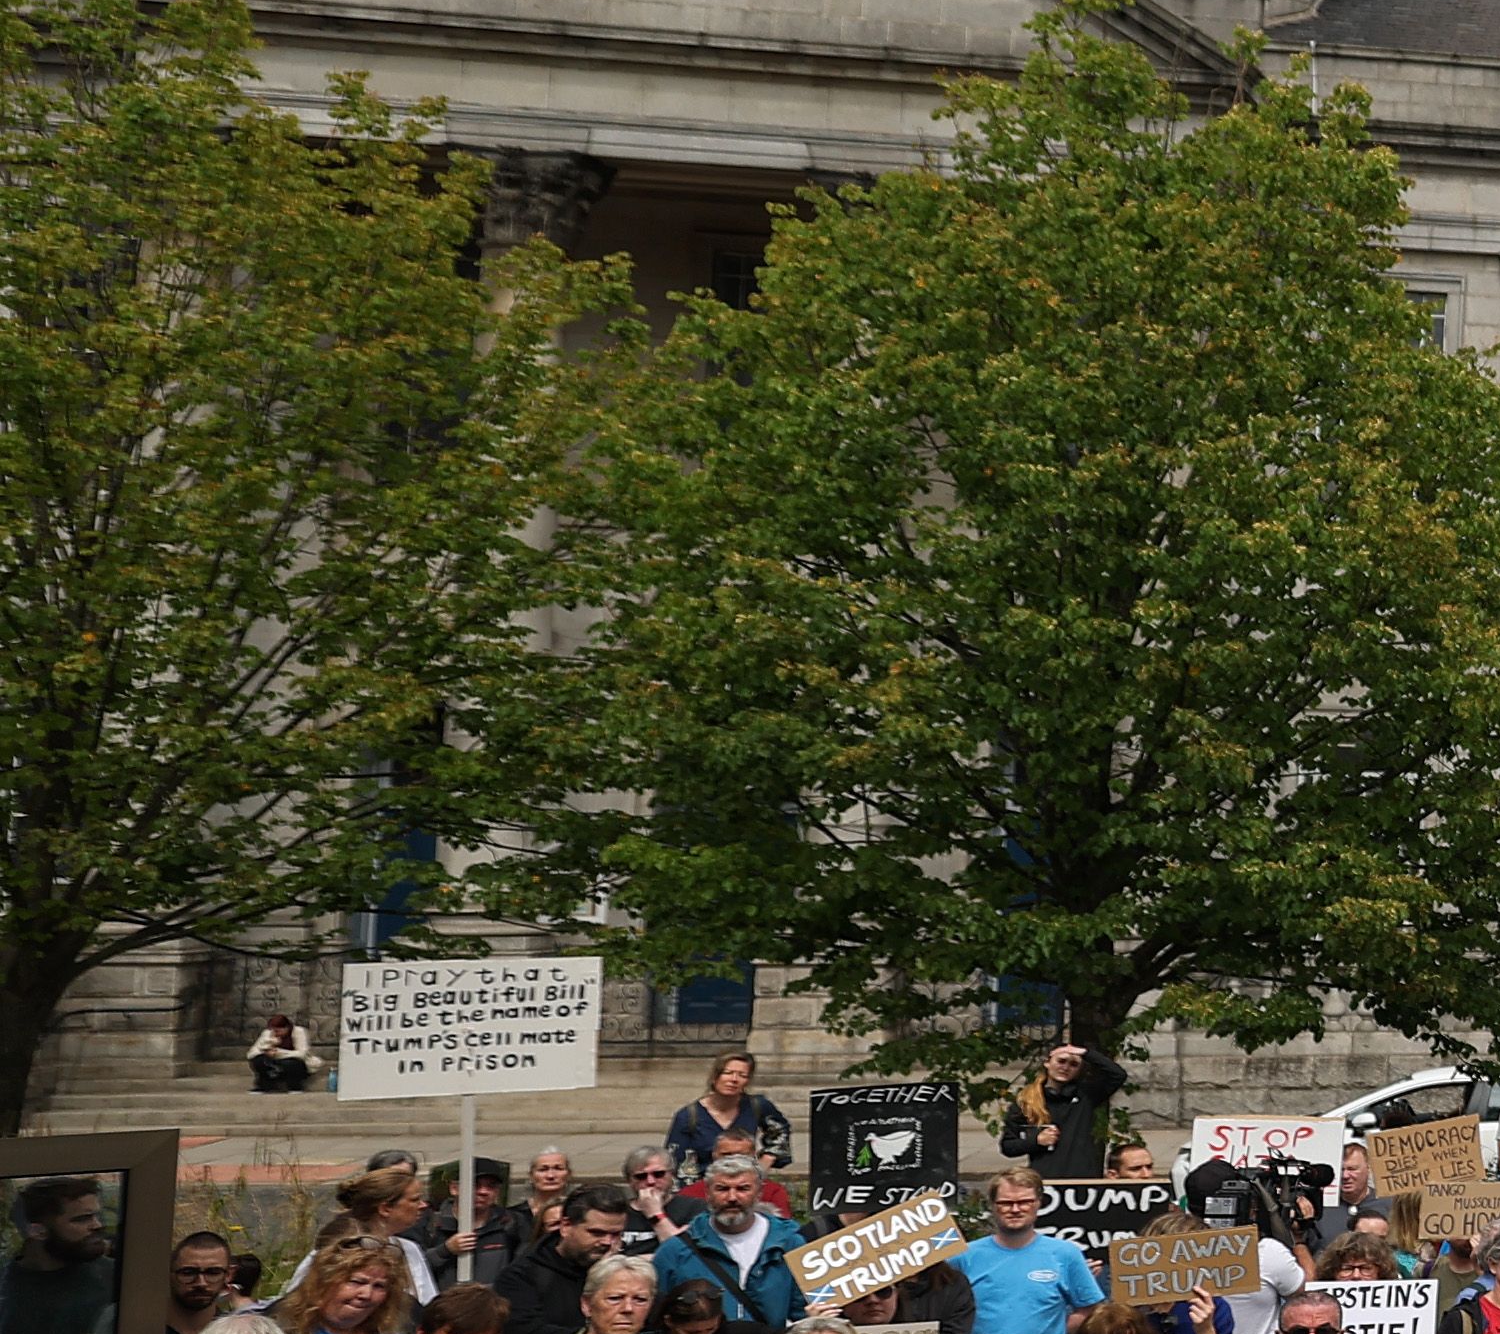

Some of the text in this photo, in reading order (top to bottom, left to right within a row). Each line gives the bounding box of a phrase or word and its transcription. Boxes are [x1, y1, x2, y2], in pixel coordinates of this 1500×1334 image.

[365, 970, 370, 988] I
[474, 967, 568, 985] that
[413, 986, 535, 1008] Beautiful
[400, 1011, 429, 1029] be
[436, 1009, 486, 1025] the
[490, 1004, 551, 1020] name
[555, 1000, 588, 1018] of
[464, 1031, 511, 1047] cell
[519, 1028, 575, 1045] mate
[809, 1085, 955, 1112] TOGETHER
[1208, 1126, 1315, 1152] STOP
[1373, 1123, 1479, 1158] DEMOCRACY
[1384, 1147, 1469, 1172] DIES WHEN
[1380, 1158, 1477, 1193] TRUMP LIES
[812, 1184, 874, 1211] WE
[1426, 1184, 1467, 1197] TANGO
[802, 1197, 947, 1281] SCOTLAND
[1118, 1234, 1252, 1268] GO AWAY
[834, 1238, 931, 1299] TRUMP
[1118, 1264, 1247, 1298] TRUMP
